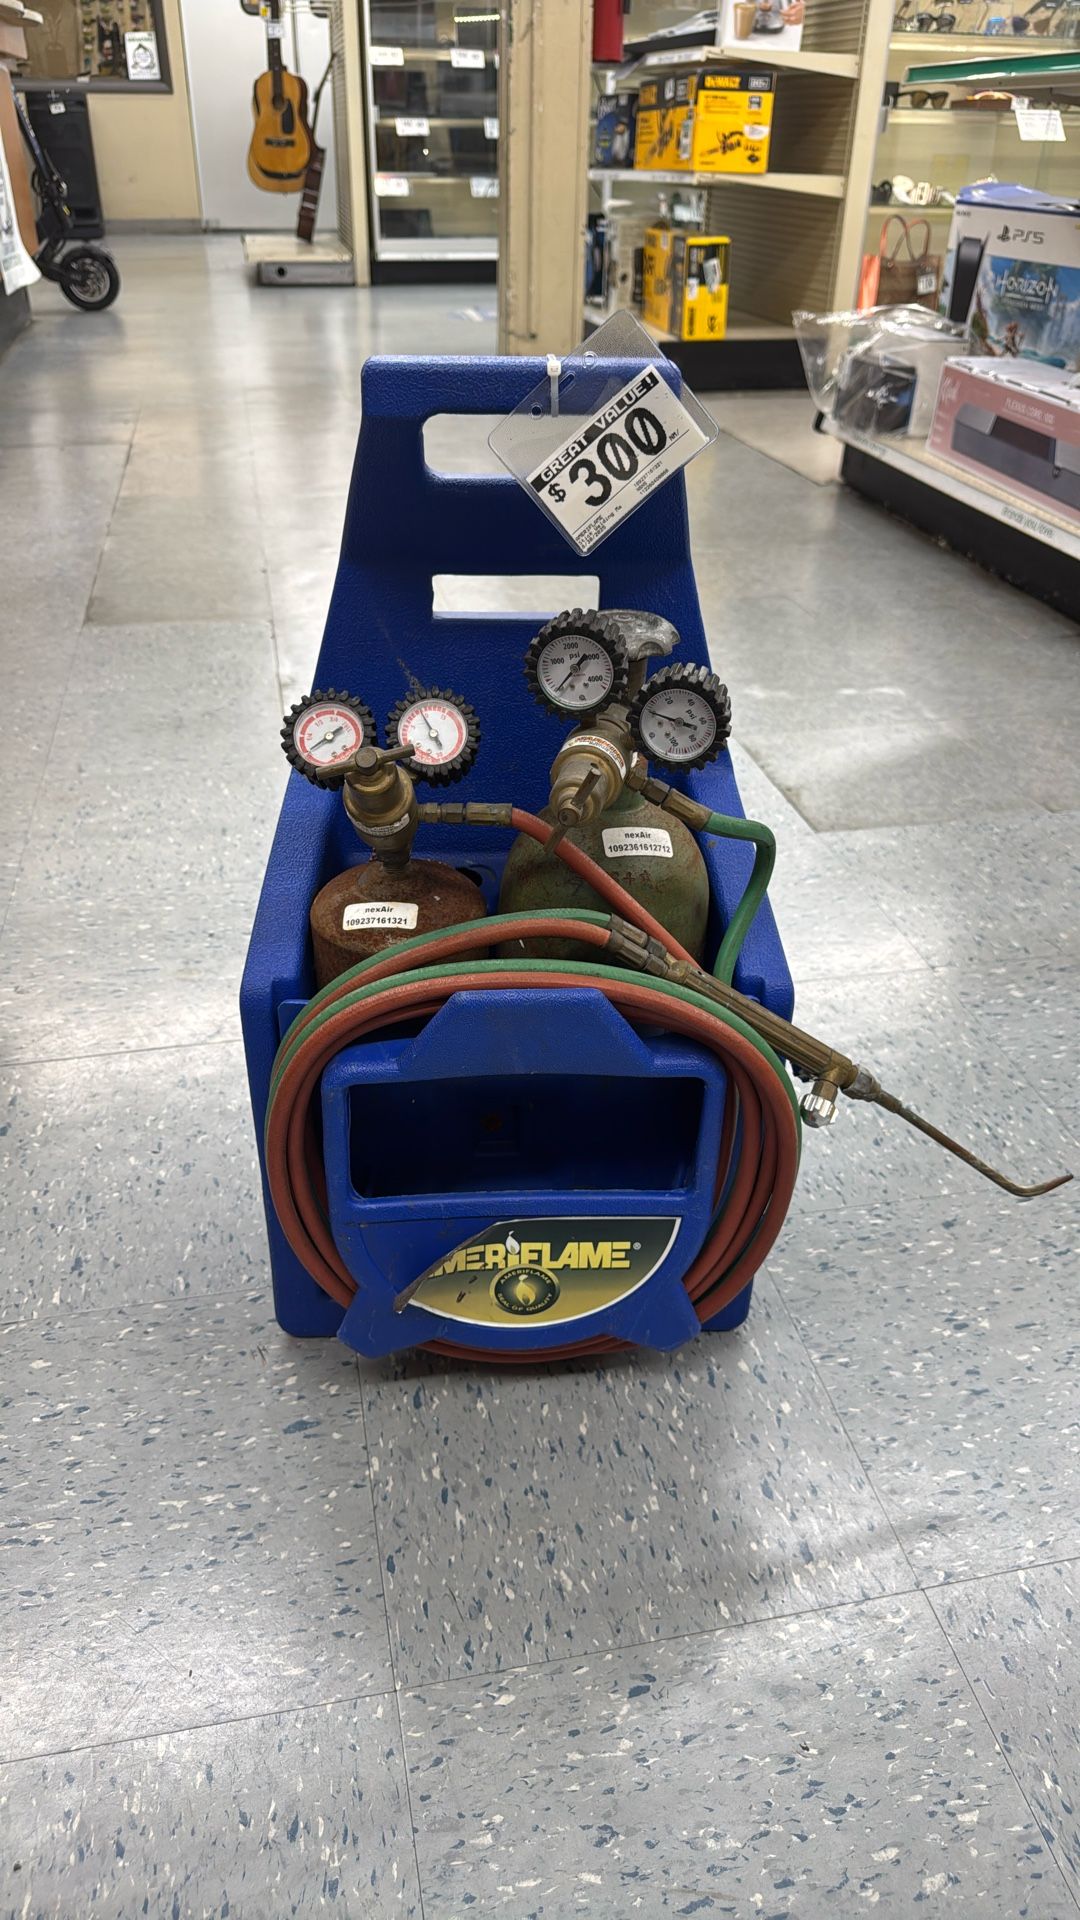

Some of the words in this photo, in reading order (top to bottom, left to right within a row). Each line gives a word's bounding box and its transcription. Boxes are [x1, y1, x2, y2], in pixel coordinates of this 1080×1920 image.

[1012, 228, 1045, 245] PS5
[540, 433, 588, 482] GREAT
[569, 407, 667, 506] 300
[563, 642, 579, 650] 2000
[569, 651, 580, 660] psi
[550, 657, 565, 665] 1000
[665, 696, 674, 705] 20
[687, 698, 696, 706] 40
[685, 709, 697, 720] psi
[669, 736, 679, 747] 100
[624, 831, 652, 839] nexAir
[608, 843, 671, 853] 1092361612712
[365, 905, 394, 913] nexAir
[345, 917, 408, 927] 109237161321
[427, 1240, 631, 1279] MERIFLAME
[500, 1269, 552, 1285] AMERIFLAME
[497, 1293, 510, 1308] SEAL
[525, 1293, 553, 1312] QUALITY
